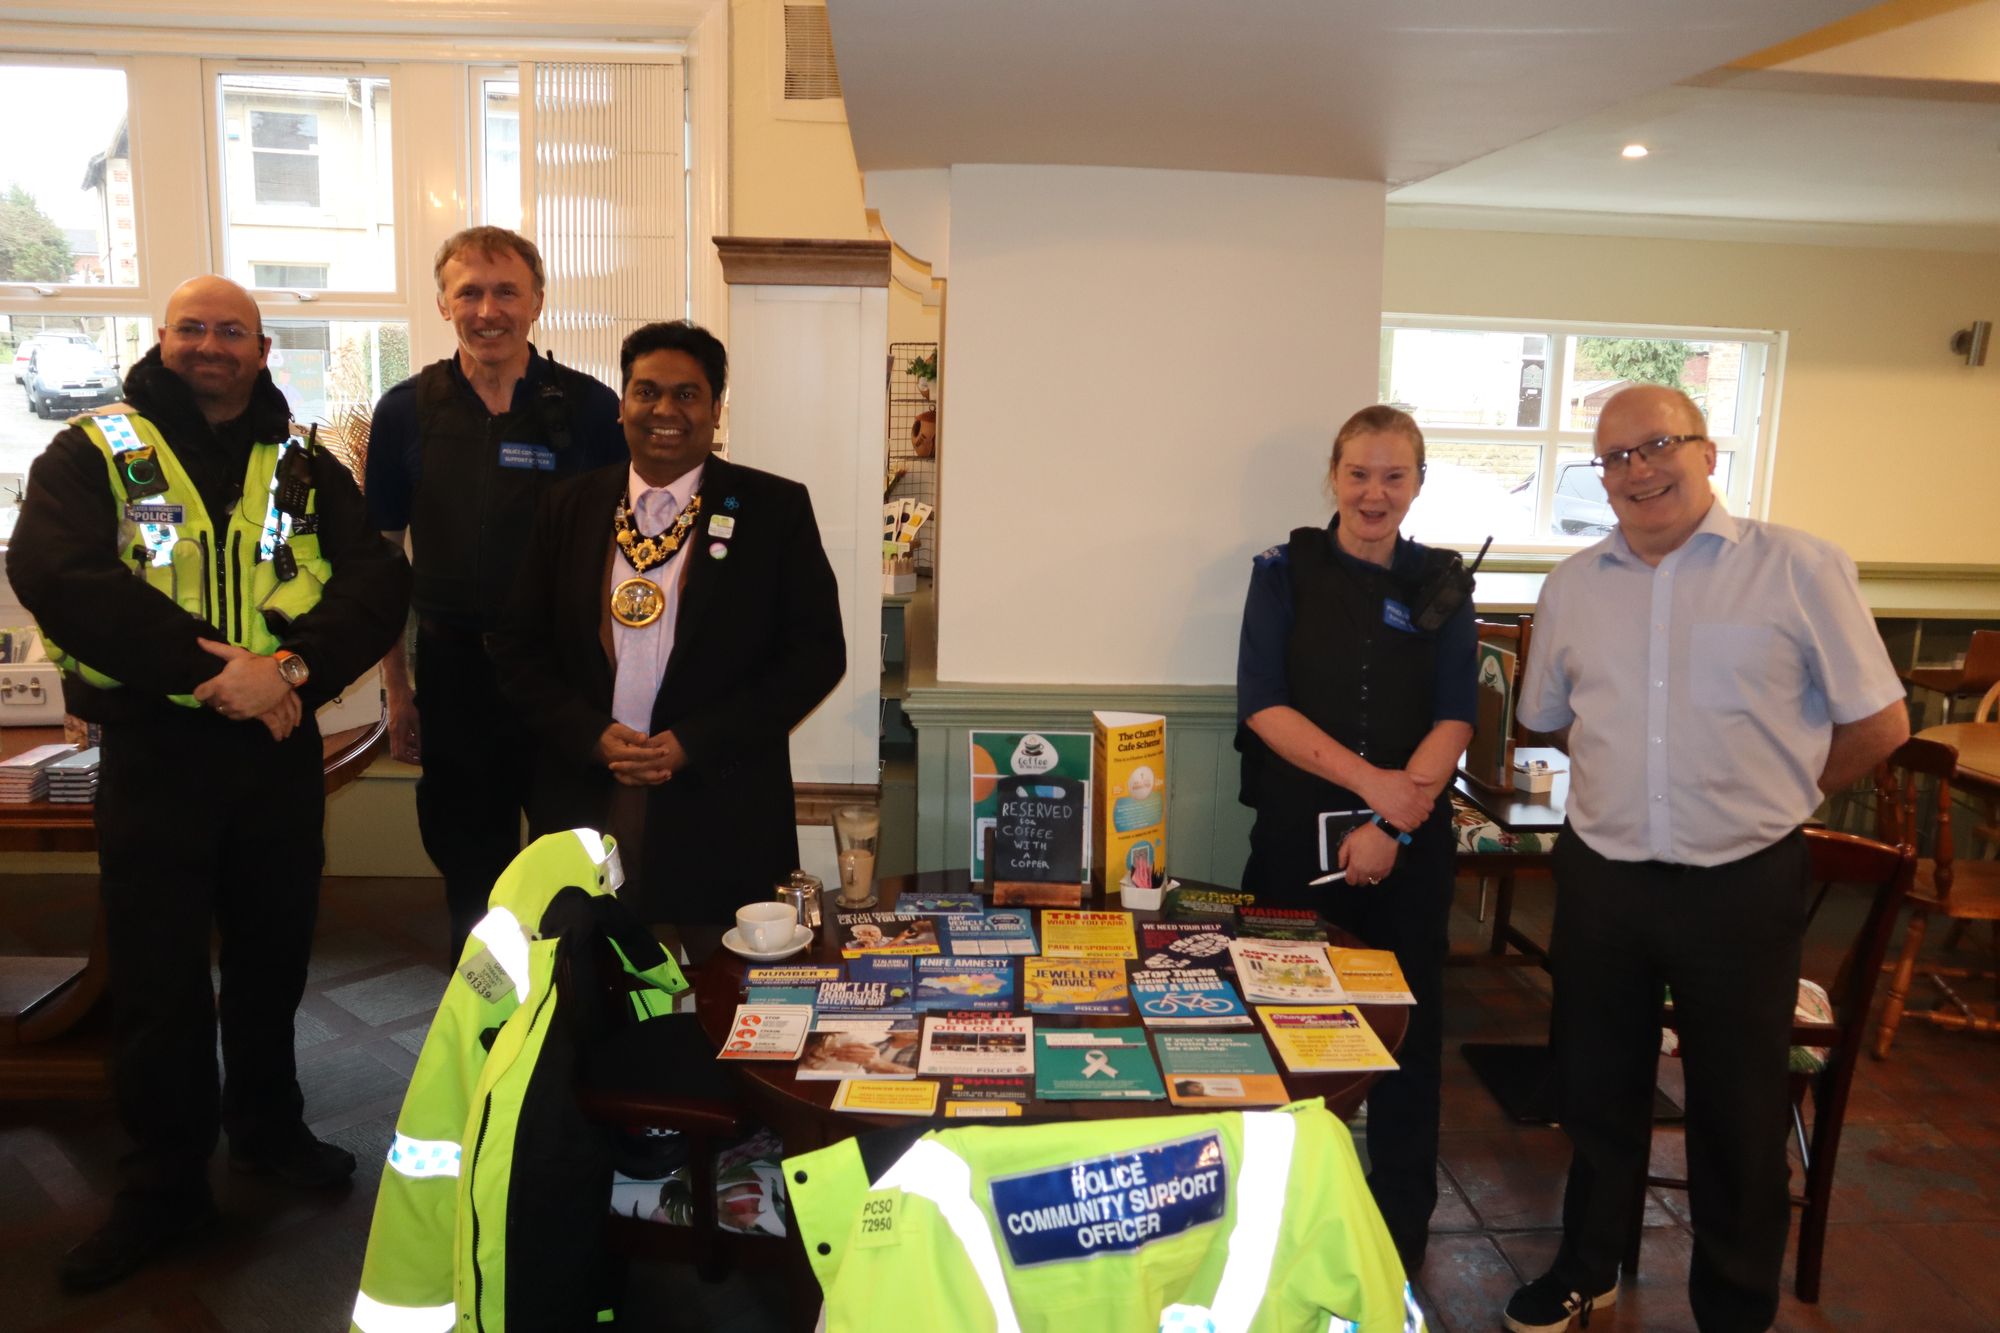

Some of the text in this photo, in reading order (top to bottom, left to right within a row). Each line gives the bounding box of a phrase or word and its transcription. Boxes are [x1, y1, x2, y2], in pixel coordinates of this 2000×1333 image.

[135, 511, 175, 522] POLICE
[1118, 728, 1157, 742] The Chatty
[1117, 742, 1135, 752] Cafe
[1002, 801, 1072, 818] RESERVED
[1002, 825, 1054, 839] COFFEE
[1013, 840, 1047, 850] WITH
[1010, 859, 1050, 869] COPPER
[1240, 907, 1317, 920] WARNING
[920, 957, 1008, 968] KNIFE AMNESTY
[1036, 969, 1115, 979] JEWELLERY
[1133, 970, 1171, 979] STOP
[466, 971, 492, 998] 61339
[820, 982, 888, 993] DON'T LET
[1051, 979, 1096, 987] ADVICE
[1136, 984, 1167, 992] FOR
[1170, 983, 1181, 991] A
[818, 991, 886, 1000] FRAUDSTERS
[947, 1011, 1013, 1019] LOCK IT
[1000, 1018, 1014, 1026] IT
[953, 1076, 1025, 1086] Payback
[1072, 1162, 1147, 1198] POLICE
[863, 1198, 893, 1216] PCSO
[1007, 1171, 1218, 1235] COMMUNITY SUPPORT
[862, 1216, 892, 1233] 72950
[1077, 1213, 1161, 1248] OFFICER
